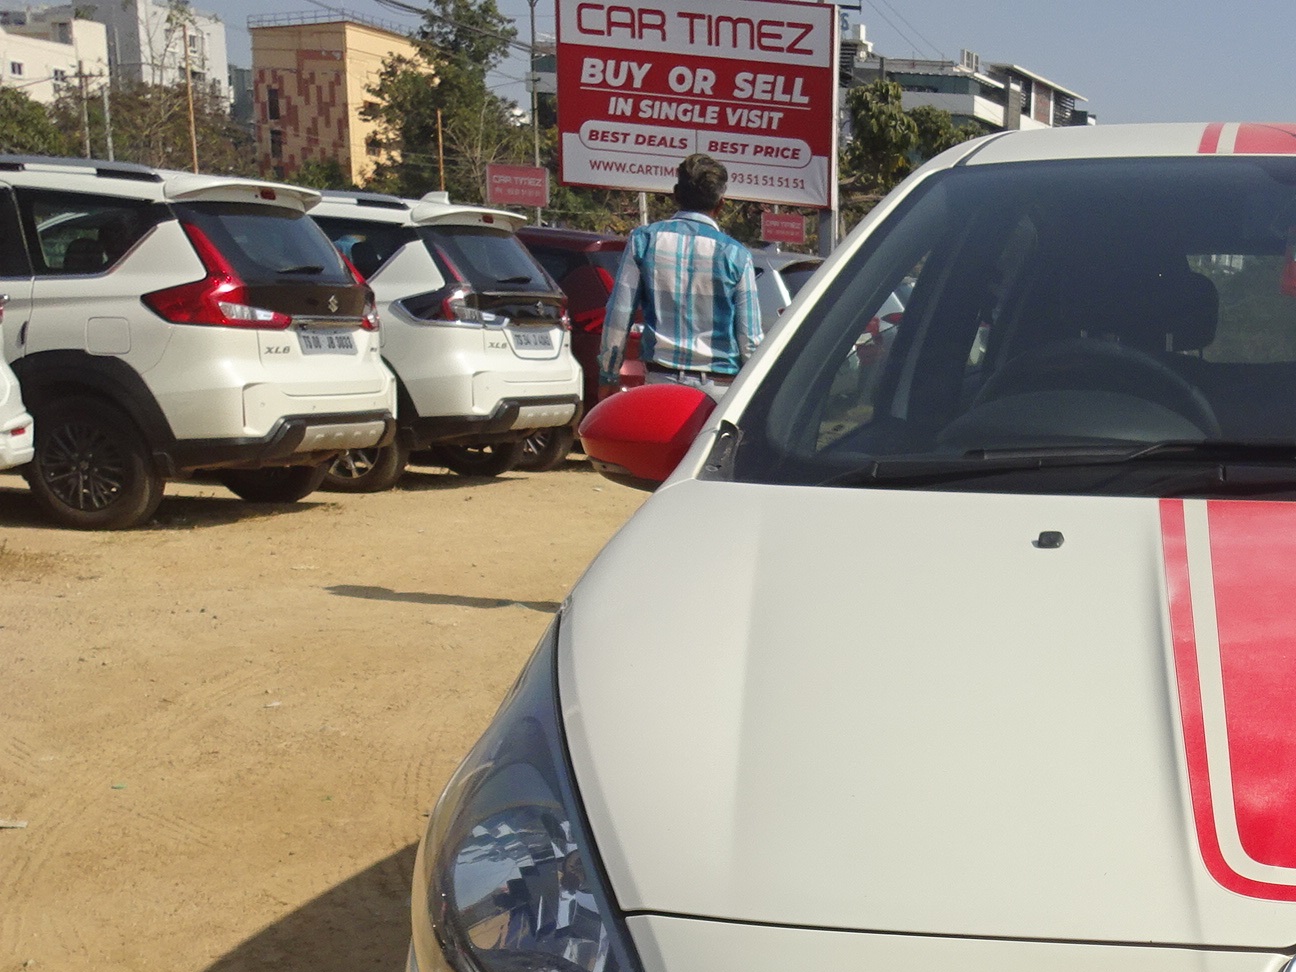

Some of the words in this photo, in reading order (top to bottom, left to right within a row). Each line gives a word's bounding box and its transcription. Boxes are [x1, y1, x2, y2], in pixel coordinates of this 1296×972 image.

[577, 3, 667, 42] CAR
[677, 11, 814, 56] TIMEZ
[580, 57, 652, 88] BUY
[668, 66, 716, 95] OR
[732, 72, 809, 104] SELL
[608, 97, 633, 116] IN
[639, 99, 718, 124] SINGLE
[726, 107, 783, 130] VISIT
[588, 129, 630, 143] BEST
[634, 133, 688, 149] DEALS
[708, 141, 749, 155] BEST
[753, 145, 801, 160] PRICE
